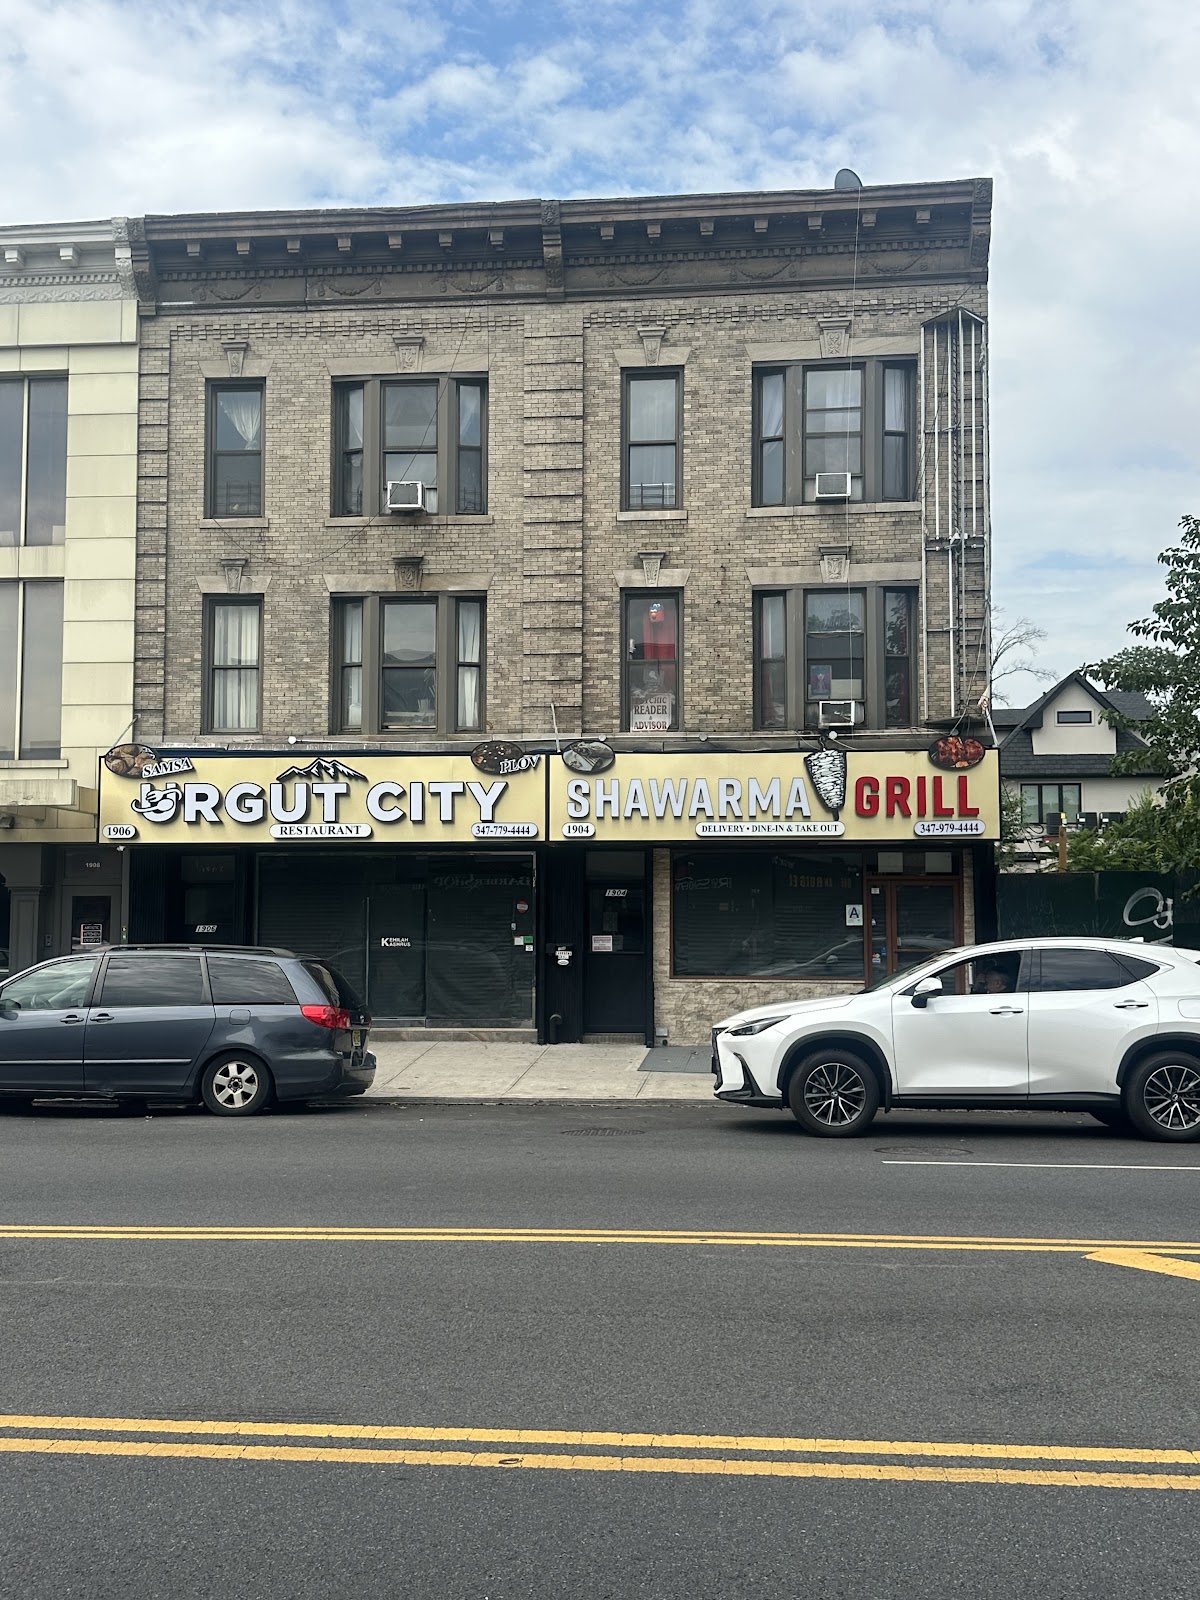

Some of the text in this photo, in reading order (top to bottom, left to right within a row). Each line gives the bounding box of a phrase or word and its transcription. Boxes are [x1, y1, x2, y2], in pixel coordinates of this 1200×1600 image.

[634, 705, 667, 714] READER
[634, 721, 667, 729] ADVISOR
[142, 757, 193, 778] SAMSA
[499, 754, 540, 774] PLOV
[135, 781, 508, 823] URGUT CITY
[566, 775, 980, 819] SHAWARMA GRILL
[106, 826, 131, 836] 1906
[279, 825, 362, 836] RESTAURANT
[475, 825, 531, 835] 347-779-4444
[566, 825, 590, 834] 1904
[701, 824, 839, 833] DELIVERY DINE-IN & TAKE OUT
[920, 823, 979, 834] 347-979-4444
[849, 907, 859, 918] A
